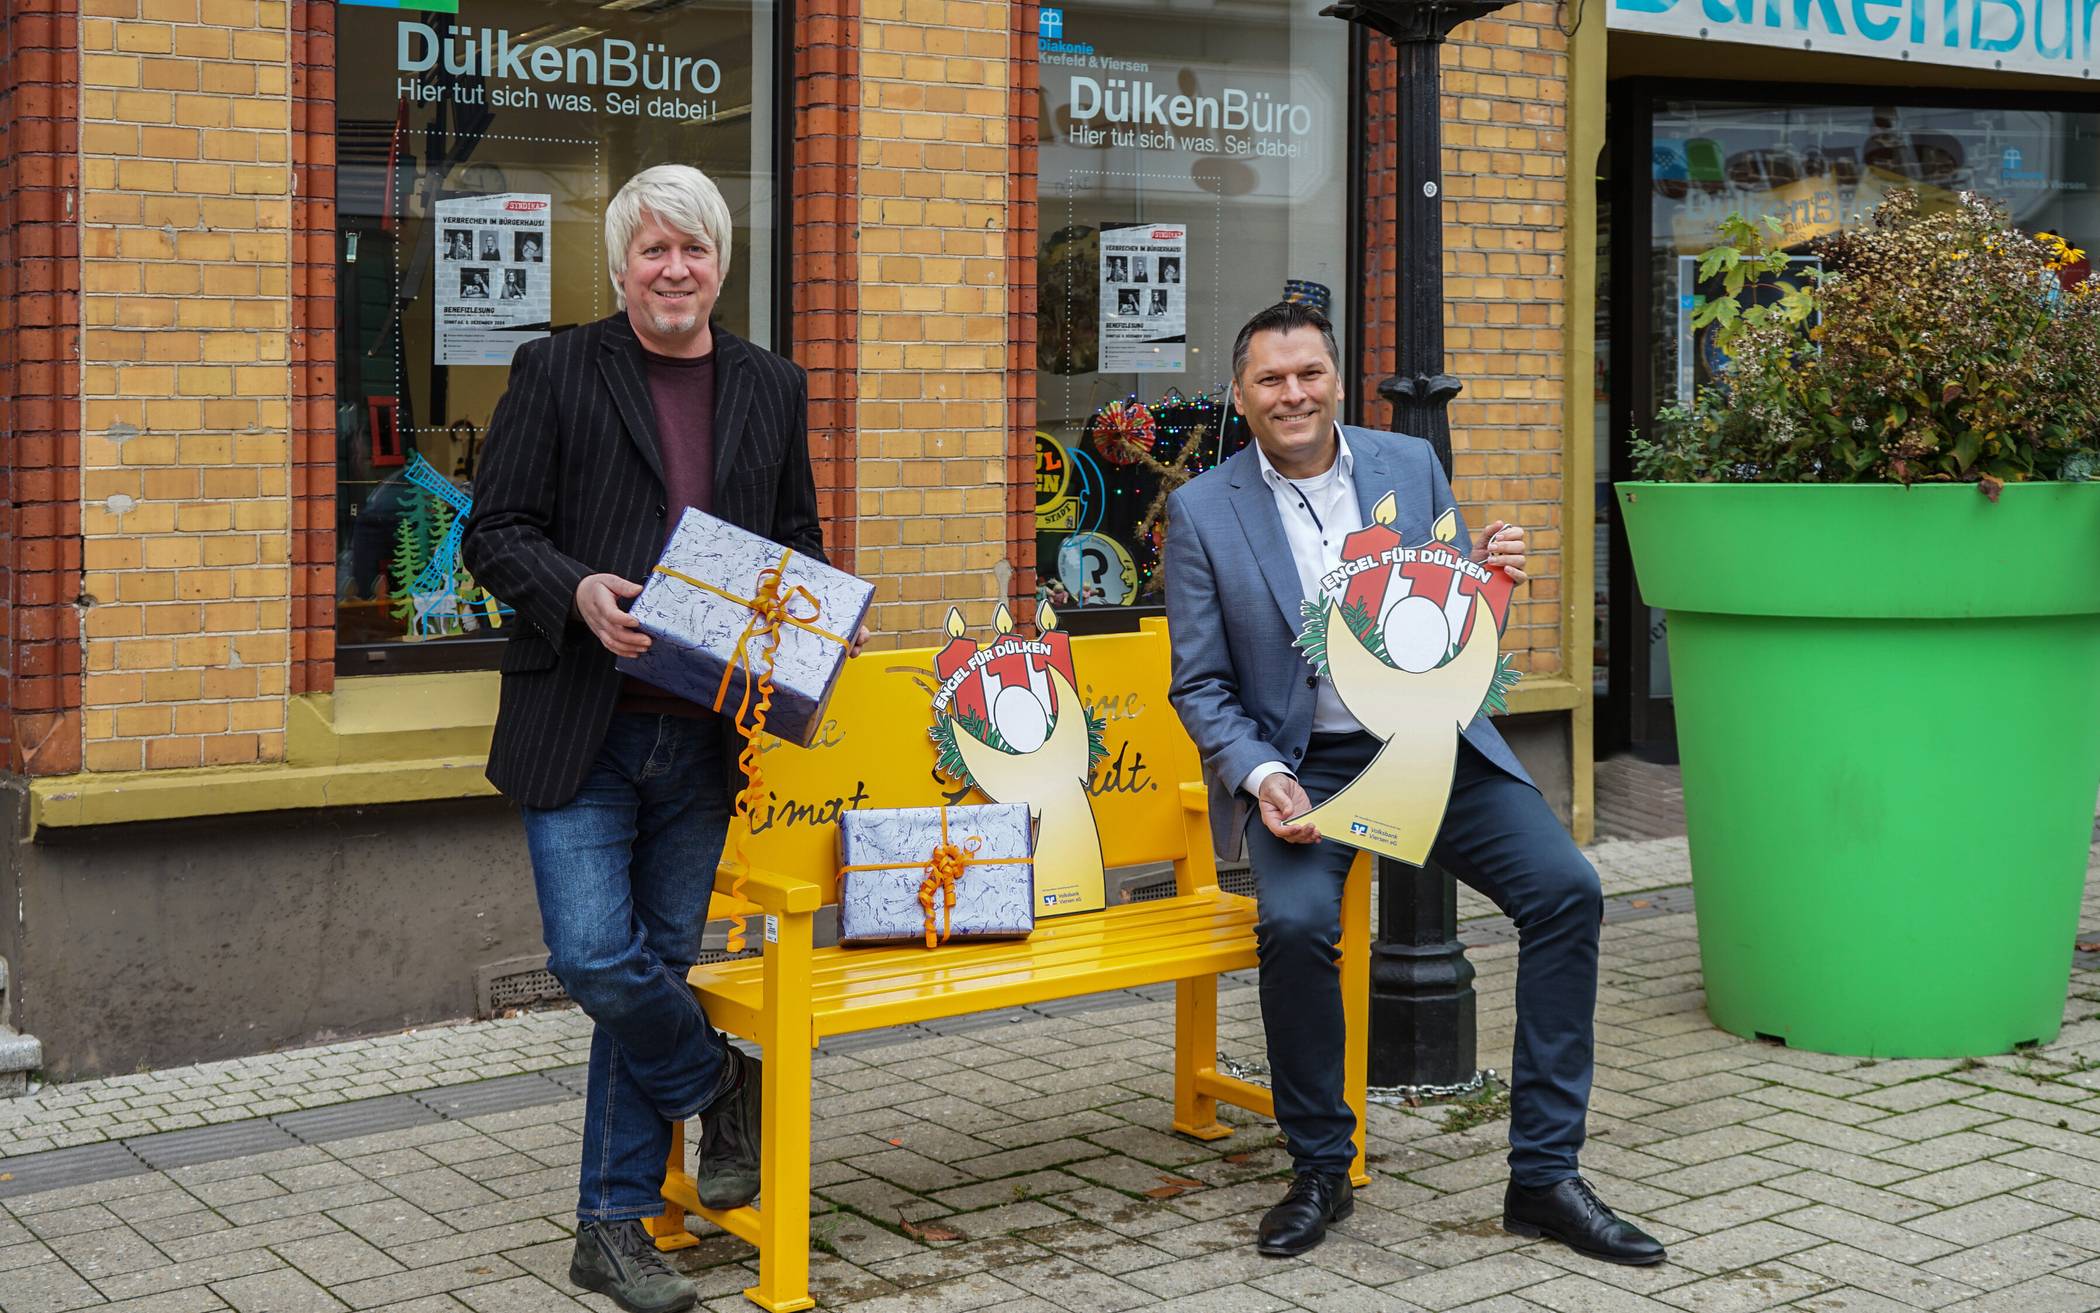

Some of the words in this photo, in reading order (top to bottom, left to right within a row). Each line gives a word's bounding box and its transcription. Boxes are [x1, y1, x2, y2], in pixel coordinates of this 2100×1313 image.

[397, 21, 721, 94] DülkenBüro
[1038, 39, 1094, 55] Diakonie
[1038, 53, 1086, 67] Krefeld
[1088, 56, 1098, 69] &
[1100, 57, 1149, 73] Viersen
[396, 77, 446, 102] Hier
[453, 82, 485, 105] tut
[491, 84, 539, 109] sich
[545, 91, 598, 113] was.
[605, 92, 640, 116] Sei
[647, 98, 717, 121] dabei!
[1070, 76, 1311, 135] DülkenBüro
[1070, 125, 1106, 145] Hier
[1110, 129, 1134, 147] tut
[1140, 130, 1174, 150] sich
[1180, 137, 1219, 153] was.
[1225, 135, 1250, 155] Sei
[443, 216, 488, 225] VERBRECHEN
[498, 217, 545, 227] BÜRGERHAUS!
[444, 306, 495, 314] BENEFIZLESUNG
[1044, 503, 1072, 525] STADT
[1321, 555, 1379, 591] ENGEL
[1381, 547, 1418, 566] FÜR
[1420, 549, 1492, 584] DÜLKEN
[933, 667, 971, 711] ENGEL
[967, 649, 995, 671] FÜR
[994, 640, 1052, 658] DÜLKEN
